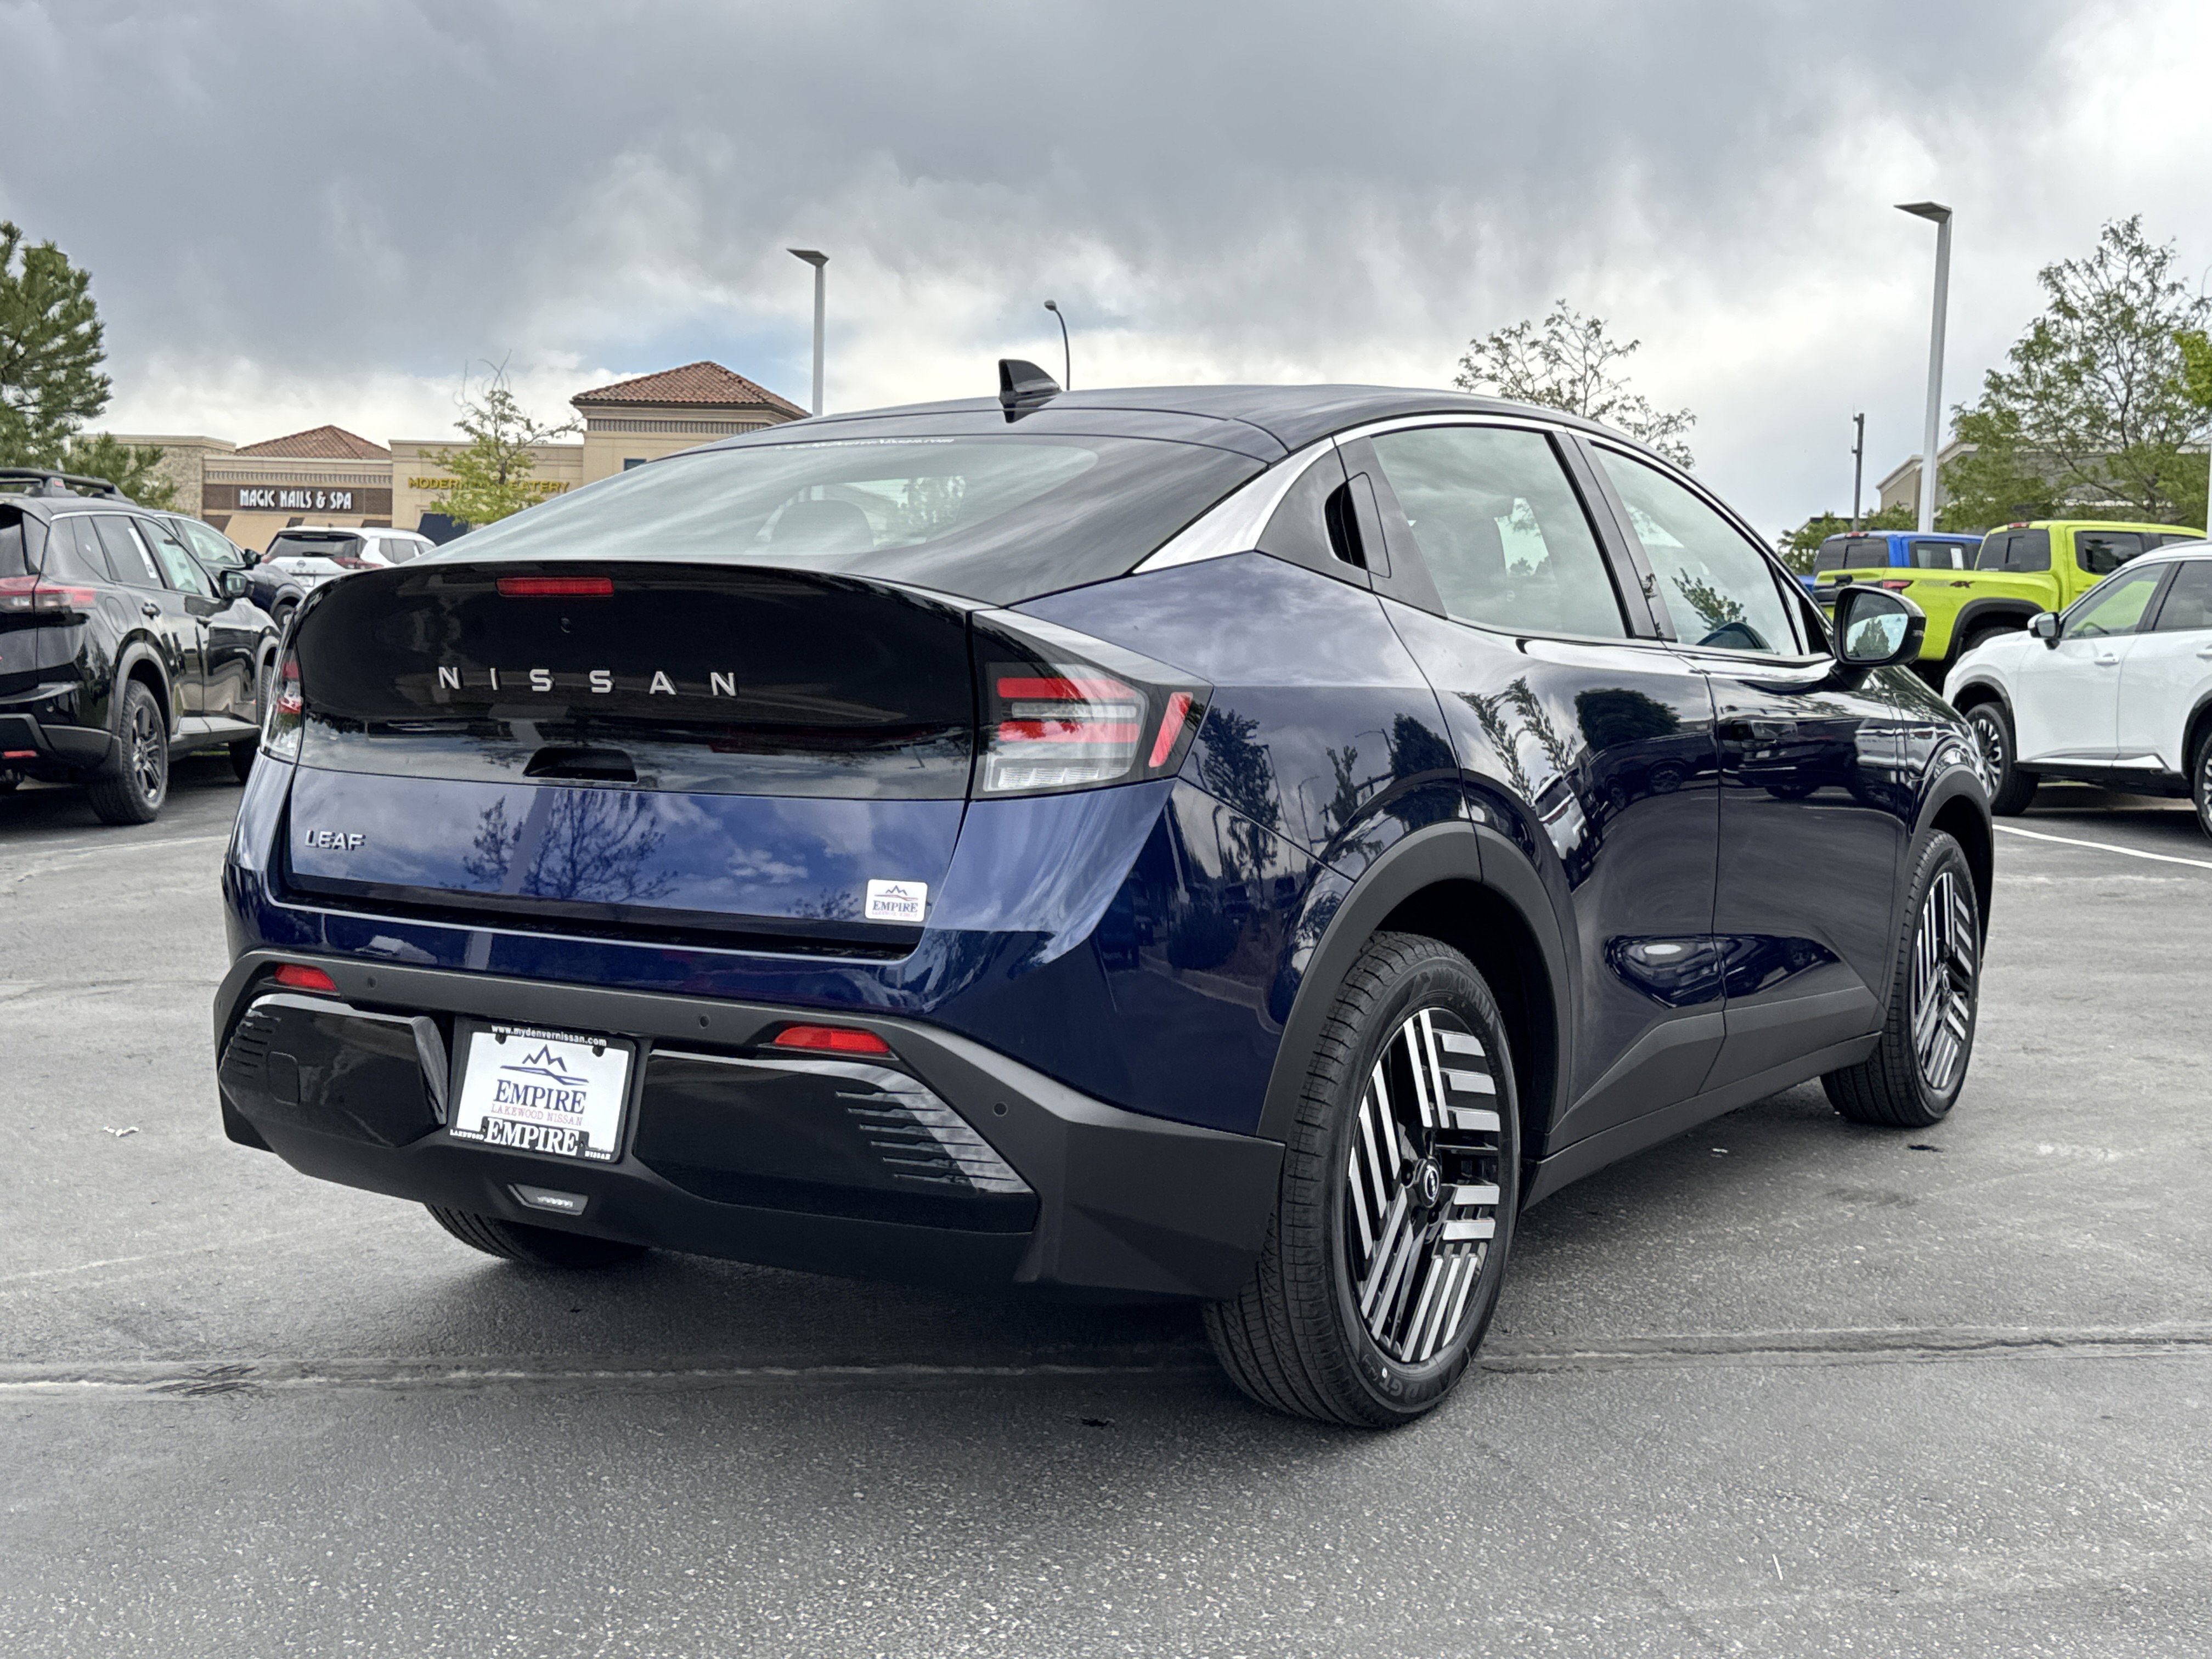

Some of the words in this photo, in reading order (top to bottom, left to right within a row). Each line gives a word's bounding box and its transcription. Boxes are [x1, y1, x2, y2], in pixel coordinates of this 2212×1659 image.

[240, 489, 275, 507] MAGIC
[280, 490, 313, 509] NAILS
[316, 491, 326, 509] &
[330, 492, 352, 510] SPA
[438, 666, 738, 697] NISSAN
[304, 829, 366, 851] LEAF
[873, 900, 918, 913] EMPIRE
[490, 1024, 607, 1047] www.mydenvernissan.com
[493, 1079, 587, 1115] EMPIRE
[490, 1103, 543, 1120] LAKEWOOD
[547, 1114, 583, 1126] NISSAN
[484, 1117, 580, 1156] EMPIRE
